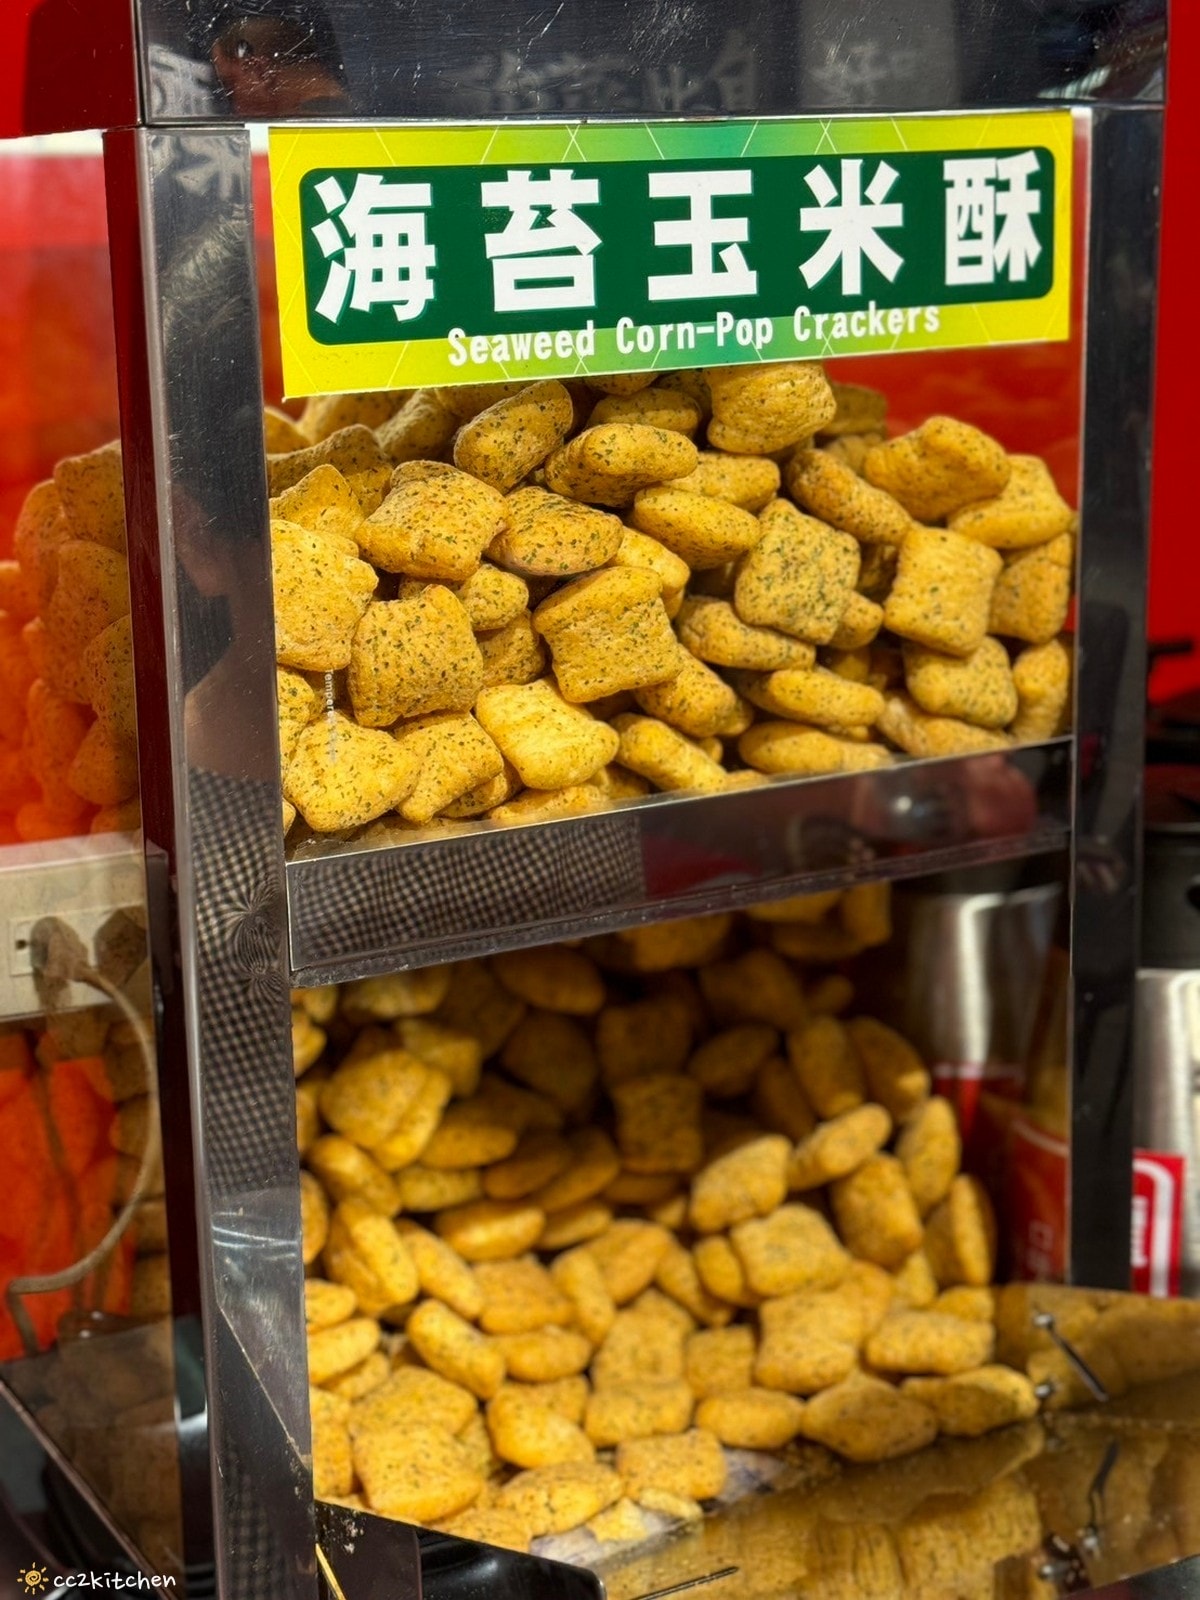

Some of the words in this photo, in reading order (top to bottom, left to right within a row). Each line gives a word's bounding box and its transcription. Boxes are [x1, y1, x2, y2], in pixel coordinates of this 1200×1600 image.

[312, 151, 1042, 323] 海苔玉米酥
[448, 320, 595, 366] Seaweed
[616, 311, 773, 355] Corn-Pop
[793, 300, 941, 342] Crackers
